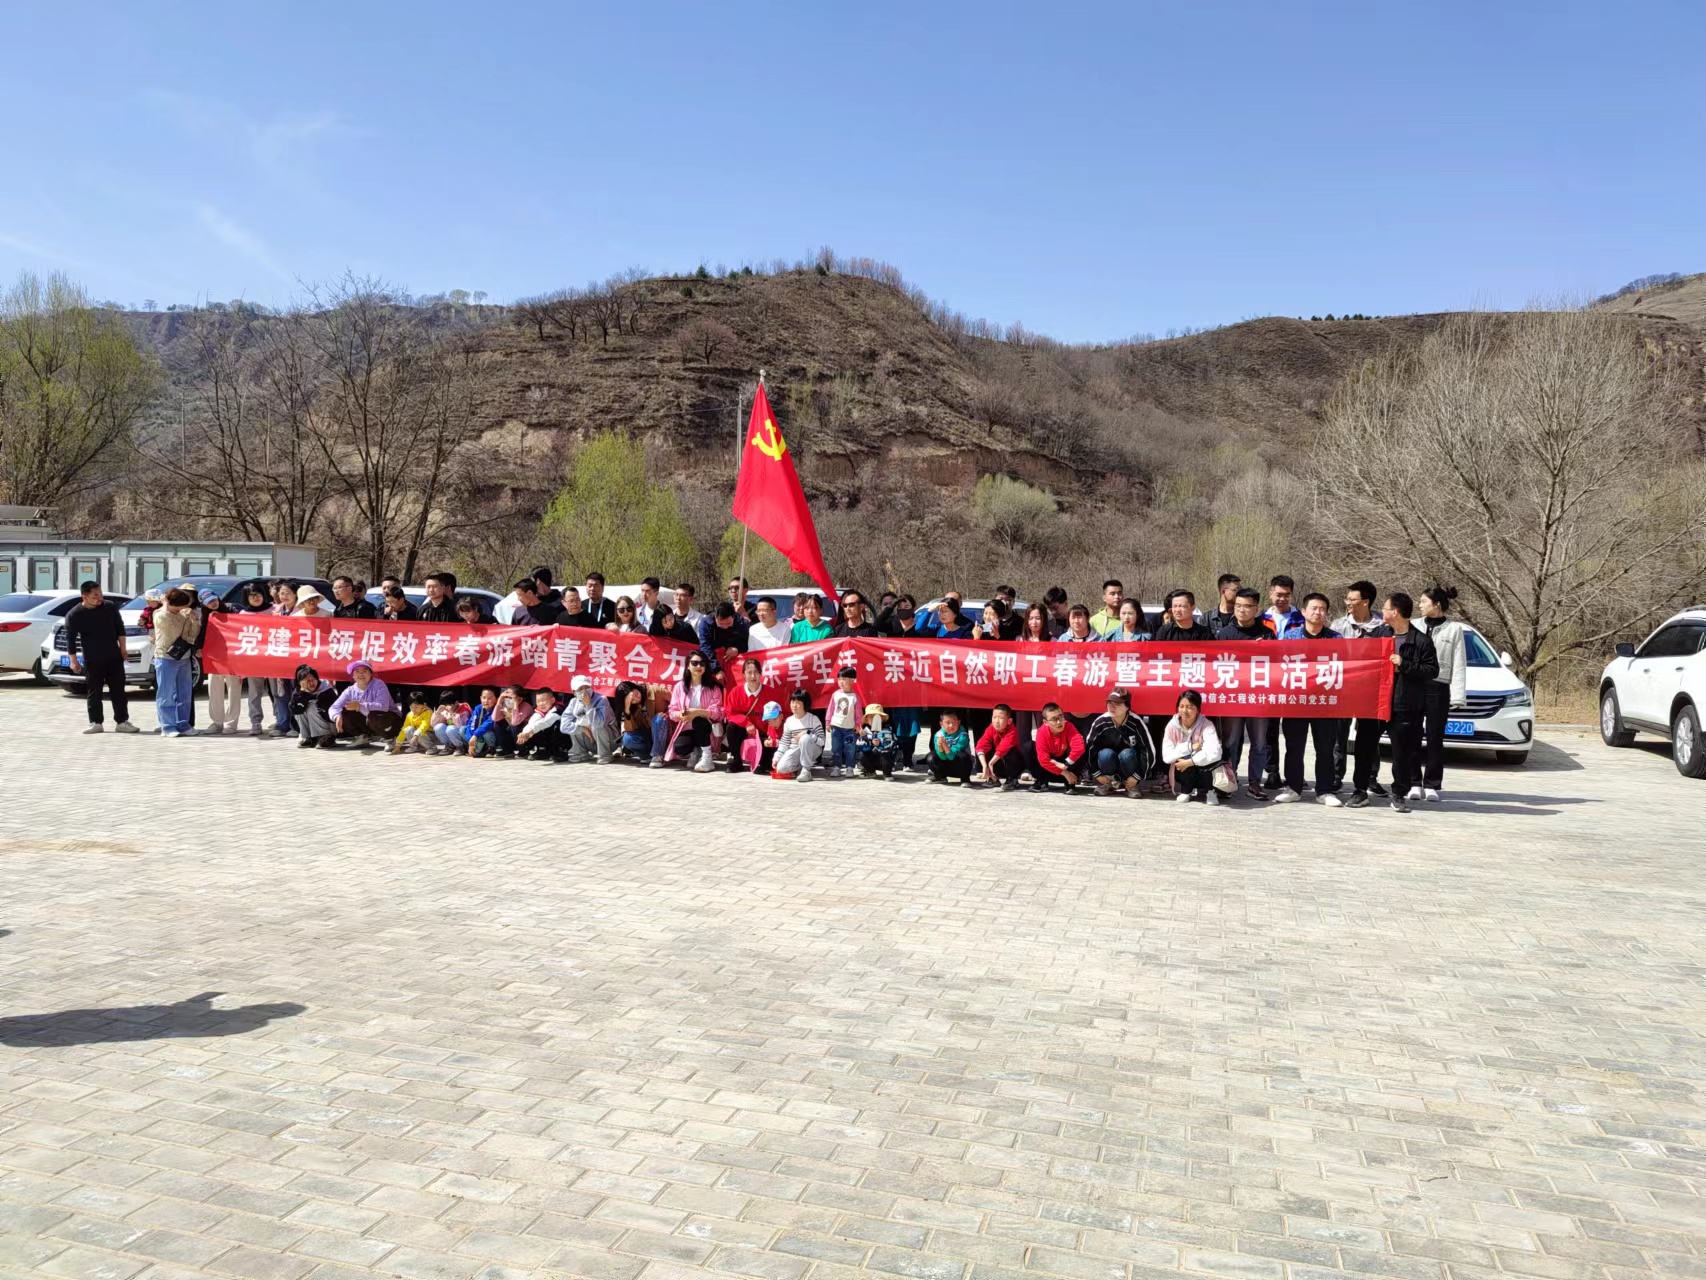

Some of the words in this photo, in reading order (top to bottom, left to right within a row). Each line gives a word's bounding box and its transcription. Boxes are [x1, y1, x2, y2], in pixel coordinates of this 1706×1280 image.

[234, 625, 687, 683] 党建引领促效率春游踏青聚合力
